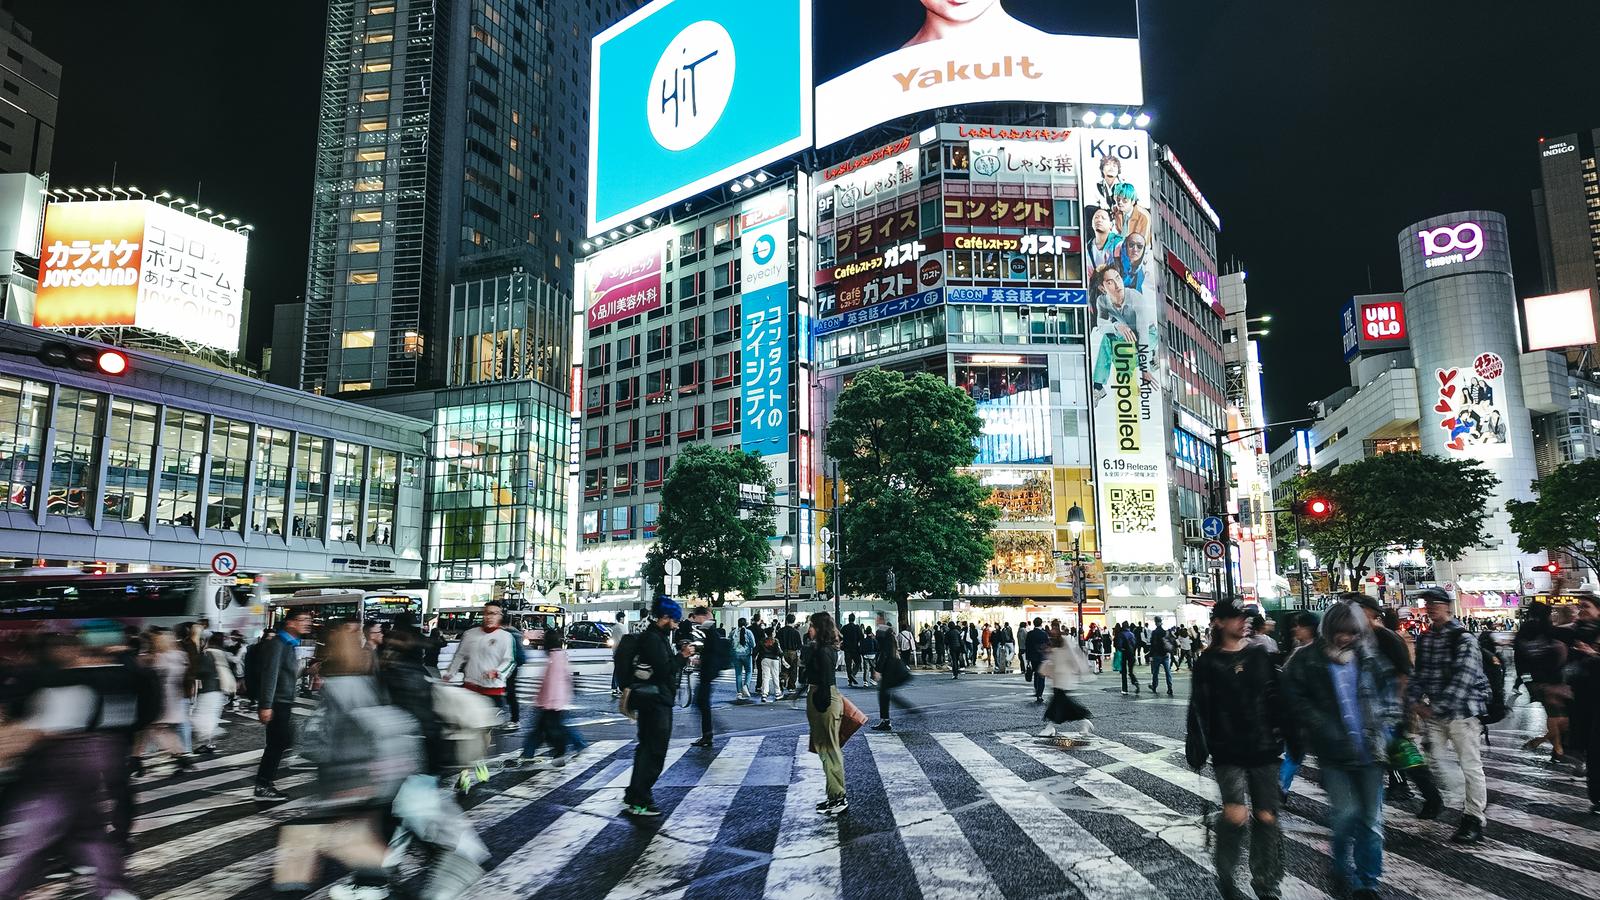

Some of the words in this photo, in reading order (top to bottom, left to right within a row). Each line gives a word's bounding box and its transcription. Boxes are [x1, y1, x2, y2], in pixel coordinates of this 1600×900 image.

[892, 55, 1043, 92] Yakult
[959, 124, 1071, 140] しゃぶしゃぶバイキング
[1090, 139, 1139, 160] Kroi
[1543, 144, 1575, 157] INDIGO
[1549, 142, 1567, 150] HOTEL
[823, 135, 912, 180] しゃぶしゃぶバイキング
[1008, 152, 1073, 173] しゃぶ葉
[864, 163, 913, 197] しゃぶ葉
[818, 196, 833, 211] 9F
[944, 200, 1050, 222] コンタクト
[838, 210, 917, 253] プライス
[1418, 222, 1484, 261] 109
[45, 239, 140, 268] カラオケ
[884, 240, 927, 269] ガスト
[1020, 234, 1071, 255] ガスト
[1425, 253, 1464, 269] SHIBUYA
[42, 267, 138, 288] JOYSOUND
[746, 263, 783, 284] eyecity
[922, 270, 940, 281] ガスト
[145, 270, 232, 307] あげていこう
[840, 286, 861, 302] Café
[863, 273, 913, 306] ガスト
[952, 289, 983, 299] AEON
[991, 288, 1085, 303] 英会話イーオン
[598, 286, 658, 320] 品川美容外科
[818, 294, 836, 312] 7F
[1365, 306, 1396, 321] UNI
[818, 318, 840, 331] AEON
[847, 297, 920, 326] 英会話イーオン
[1367, 320, 1400, 338] QLO
[768, 305, 783, 428] コンタクトの
[1138, 343, 1149, 373] New
[746, 311, 765, 430] アイシティ
[1111, 342, 1140, 452] Unspoiled
[1141, 373, 1152, 420] Album
[1103, 458, 1125, 470] 6.19
[1126, 462, 1158, 471] Release
